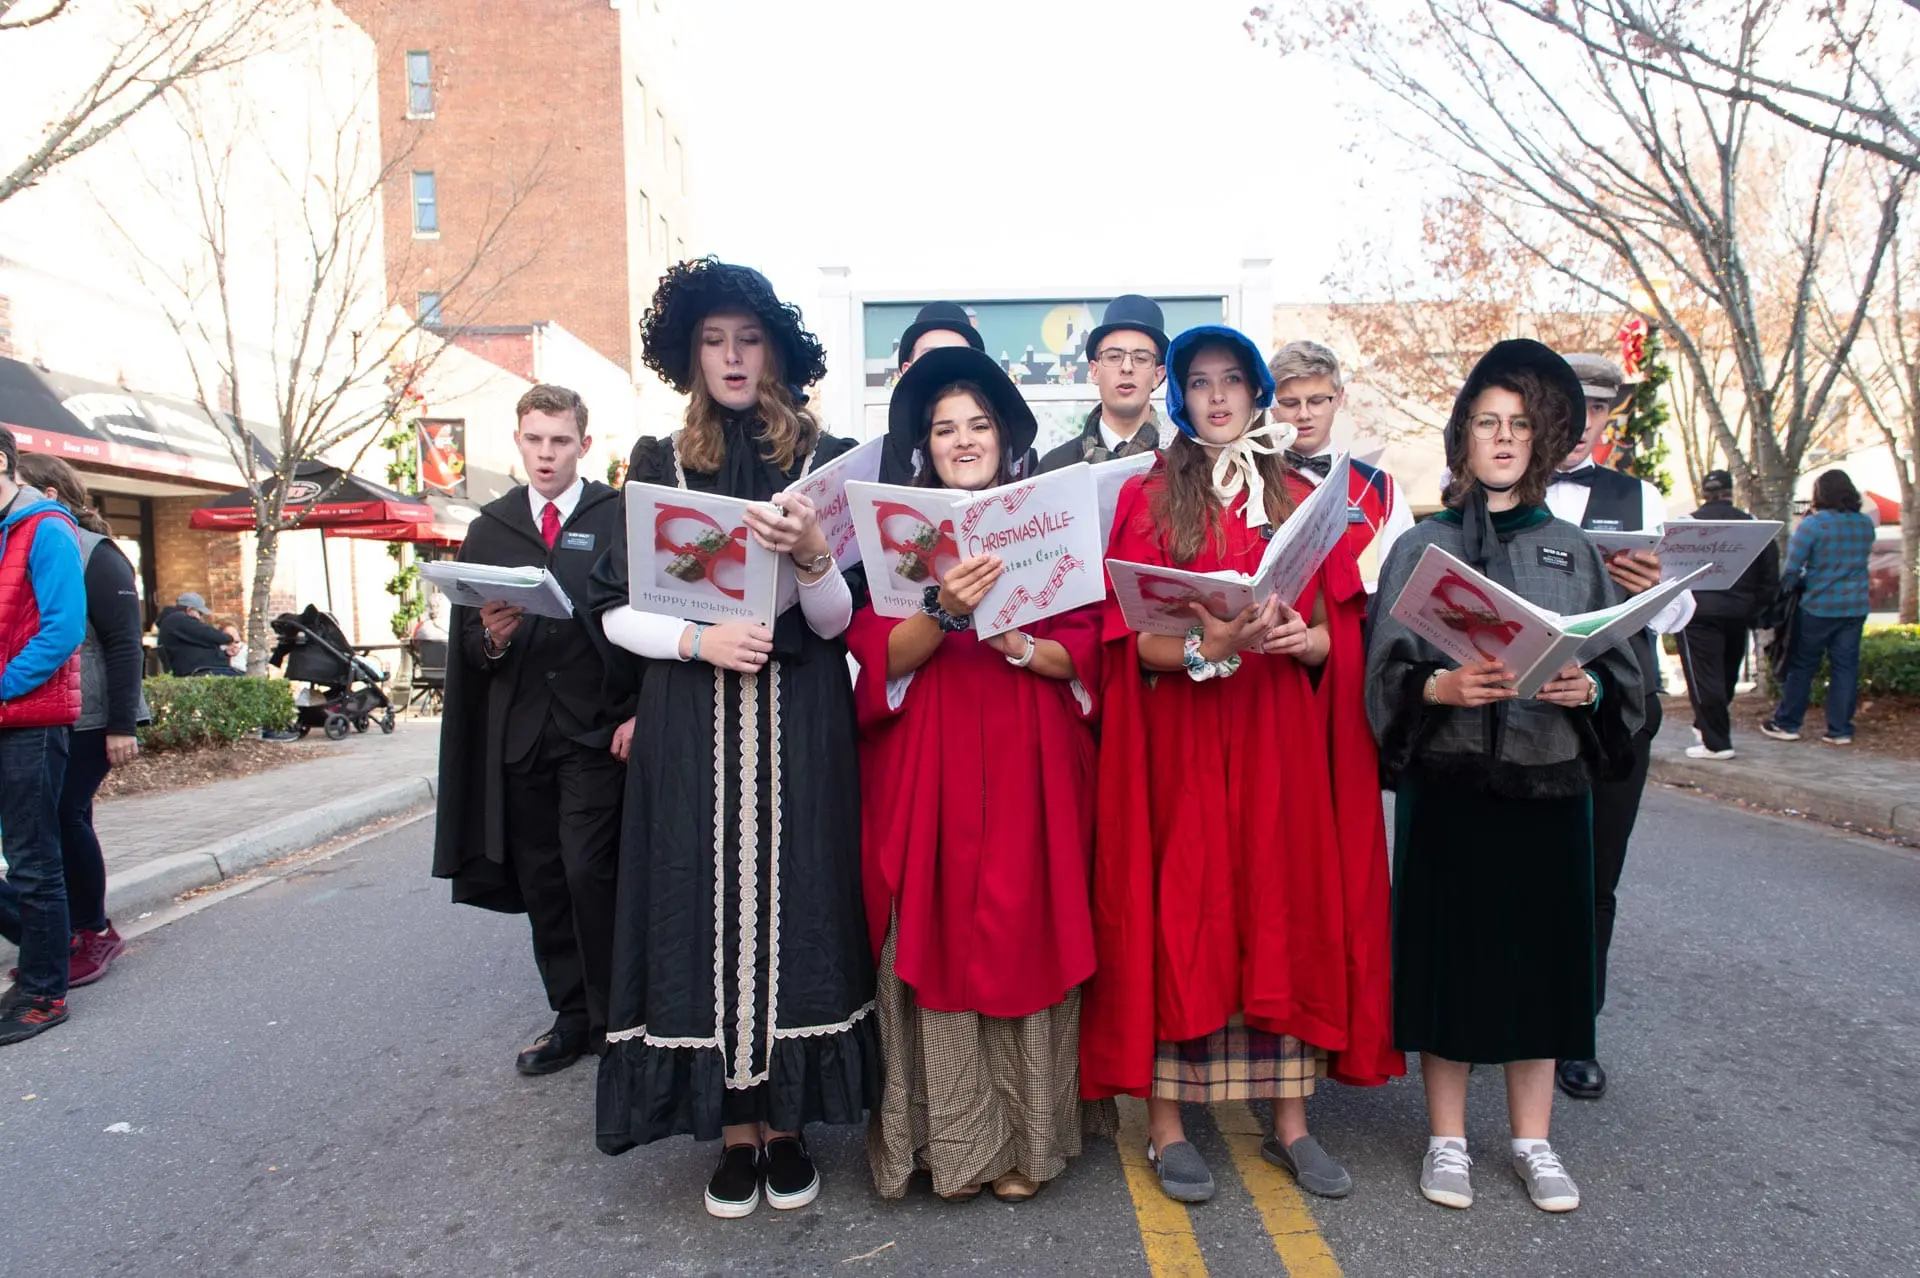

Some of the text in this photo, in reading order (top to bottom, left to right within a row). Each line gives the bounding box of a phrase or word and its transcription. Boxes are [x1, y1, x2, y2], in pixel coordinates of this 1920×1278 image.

[1005, 543, 1069, 573] stmas Carols
[642, 591, 755, 617] HAPPY HOLIDAYS
